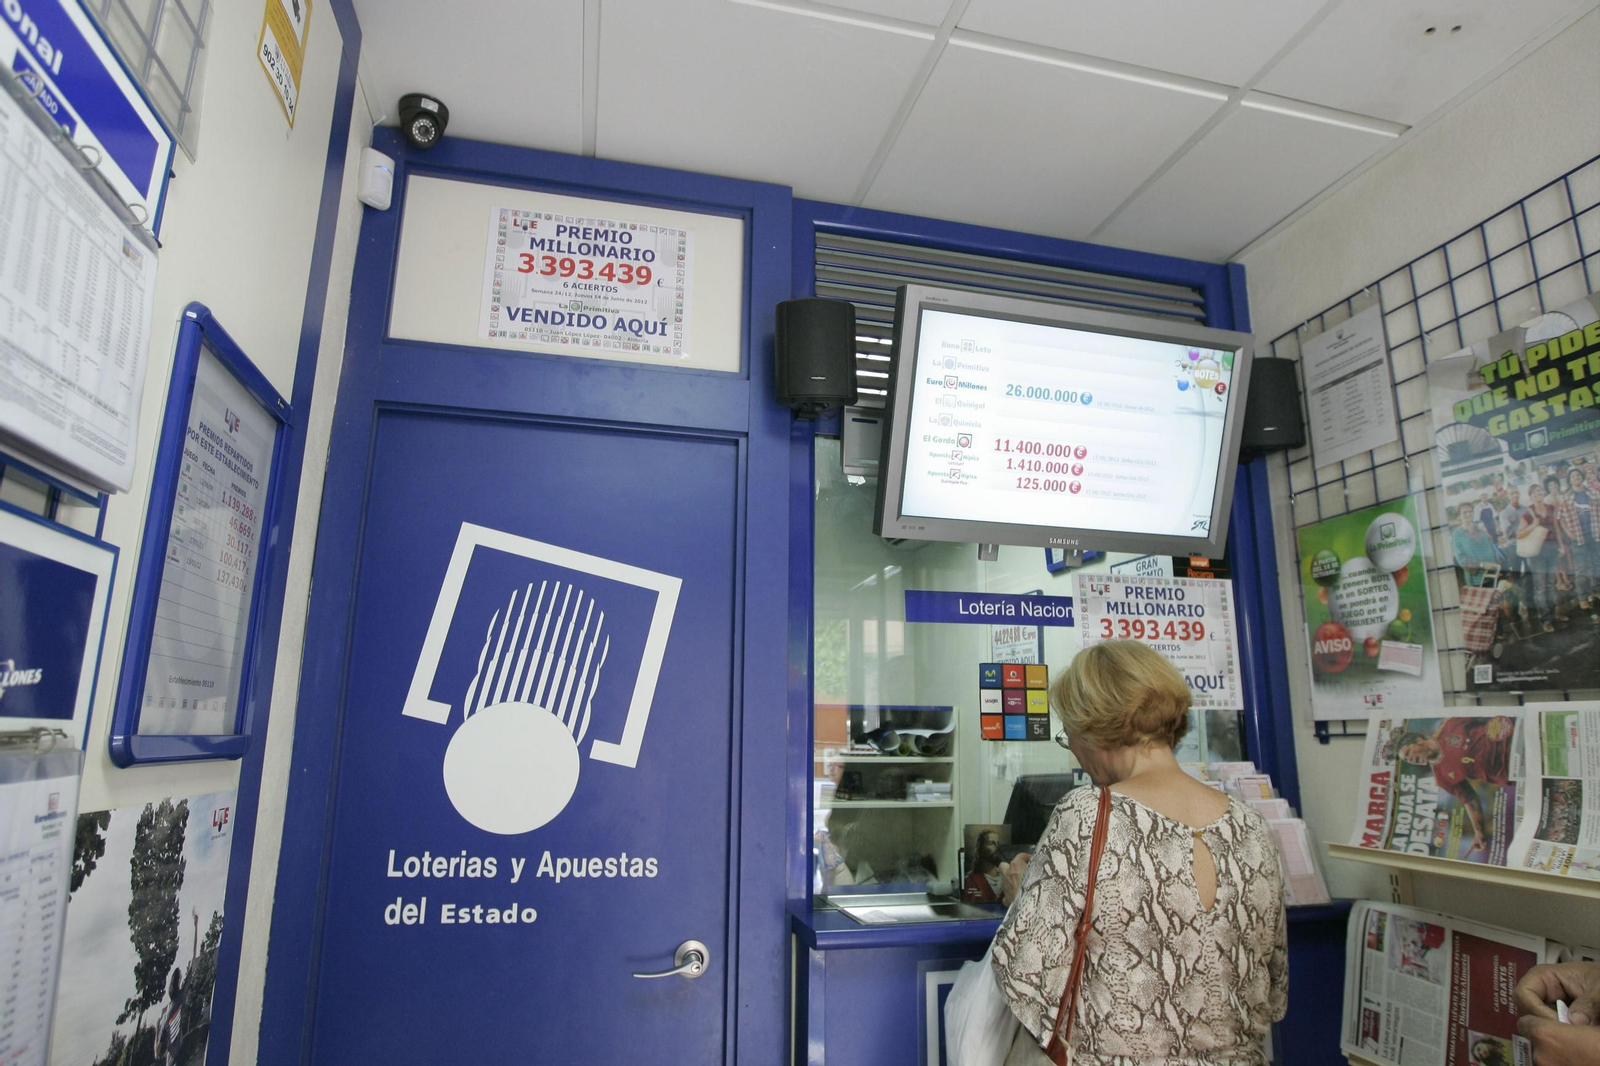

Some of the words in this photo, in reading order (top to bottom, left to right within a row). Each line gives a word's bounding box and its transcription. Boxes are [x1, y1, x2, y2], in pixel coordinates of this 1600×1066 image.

[262, 44, 276, 71] 902
[275, 67, 284, 86] 30
[556, 224, 633, 245] PREMIO
[530, 237, 656, 263] MILLONARIO
[517, 252, 652, 286] 3.393.439
[531, 288, 553, 296] Semana
[554, 290, 573, 298] 24/12,
[610, 295, 625, 303] Junio
[634, 298, 648, 306] 2012
[562, 281, 569, 289] 6
[571, 282, 618, 294] ACIERTOS
[583, 305, 620, 315] Primitiva
[506, 305, 607, 331] VENDIDO
[613, 317, 668, 338] AQUÍ
[564, 331, 582, 339] López
[627, 336, 649, 344] Almería
[941, 341, 960, 351] Bono
[975, 345, 992, 354] Loto
[932, 359, 942, 367] La
[957, 361, 990, 373] Primitiva
[1194, 369, 1220, 381] BOTES
[1479, 350, 1521, 385] TÚ
[926, 377, 943, 387] Euro
[958, 381, 988, 392] Millones
[1005, 383, 1078, 405] 26.000.000
[934, 397, 943, 405] El
[956, 400, 986, 411] Quinigol
[1452, 385, 1509, 424] QUE
[1514, 367, 1560, 401] NO
[928, 416, 938, 425] La
[953, 418, 982, 429] Quiniela
[198, 421, 224, 448] PREMIOS
[223, 441, 254, 473] REPARTIDOS
[923, 434, 931, 443] El
[932, 435, 956, 446] Gordo
[994, 438, 1071, 460] 11.400.000
[1512, 442, 1525, 452] La
[186, 426, 200, 443] POR
[200, 435, 214, 457] ESTE
[214, 447, 259, 490] ESTABLECIMIENTO
[928, 451, 951, 460] Apuesta
[183, 447, 198, 463] JUEGO
[202, 460, 216, 476] FECHA
[230, 482, 247, 499] PREMIOS
[927, 470, 949, 479] Apuesta
[1006, 457, 1069, 476] 1.410.000
[1016, 476, 1067, 493] 125.000
[221, 490, 254, 521] 1.139.288
[228, 516, 252, 538] 46.669
[226, 534, 249, 556] 30.117
[1048, 537, 1080, 547] SAMSUNG
[219, 550, 247, 573] 100.417
[1135, 557, 1158, 573] GRAN
[216, 569, 244, 591] 137.430
[1342, 578, 1369, 590] genere
[1371, 574, 1391, 583] BOTE
[1125, 586, 1186, 602] PREMIO
[1357, 584, 1391, 596] SORTEO,
[958, 598, 1016, 617] Lotería
[1106, 601, 1205, 618] MILLONARIO
[1339, 601, 1348, 609] se
[1349, 597, 1377, 608] pondrá
[1379, 595, 1389, 603] en
[1341, 609, 1365, 619] JUEGO
[1379, 605, 1387, 613] el
[1149, 644, 1181, 652] CIERTOS
[1314, 637, 1352, 655] AVISO
[0, 667, 43, 688] LONES
[168, 675, 201, 687] Establecimiento
[1185, 670, 1225, 693] AQUÍ
[1400, 774, 1417, 793] SE
[1359, 771, 1391, 849] MARCA
[1395, 794, 1415, 835] ROJA
[1406, 776, 1440, 856] DESATA
[386, 848, 498, 879] Loterias
[510, 857, 525, 884] y
[536, 850, 659, 884] Apuestas
[1563, 853, 1574, 869] HOY
[384, 896, 427, 926] del
[440, 902, 538, 925] Estado
[1453, 985, 1459, 995] LA
[1499, 965, 1508, 1006] GRATIS
[1449, 1024, 1459, 1061] PRIMAVERA
